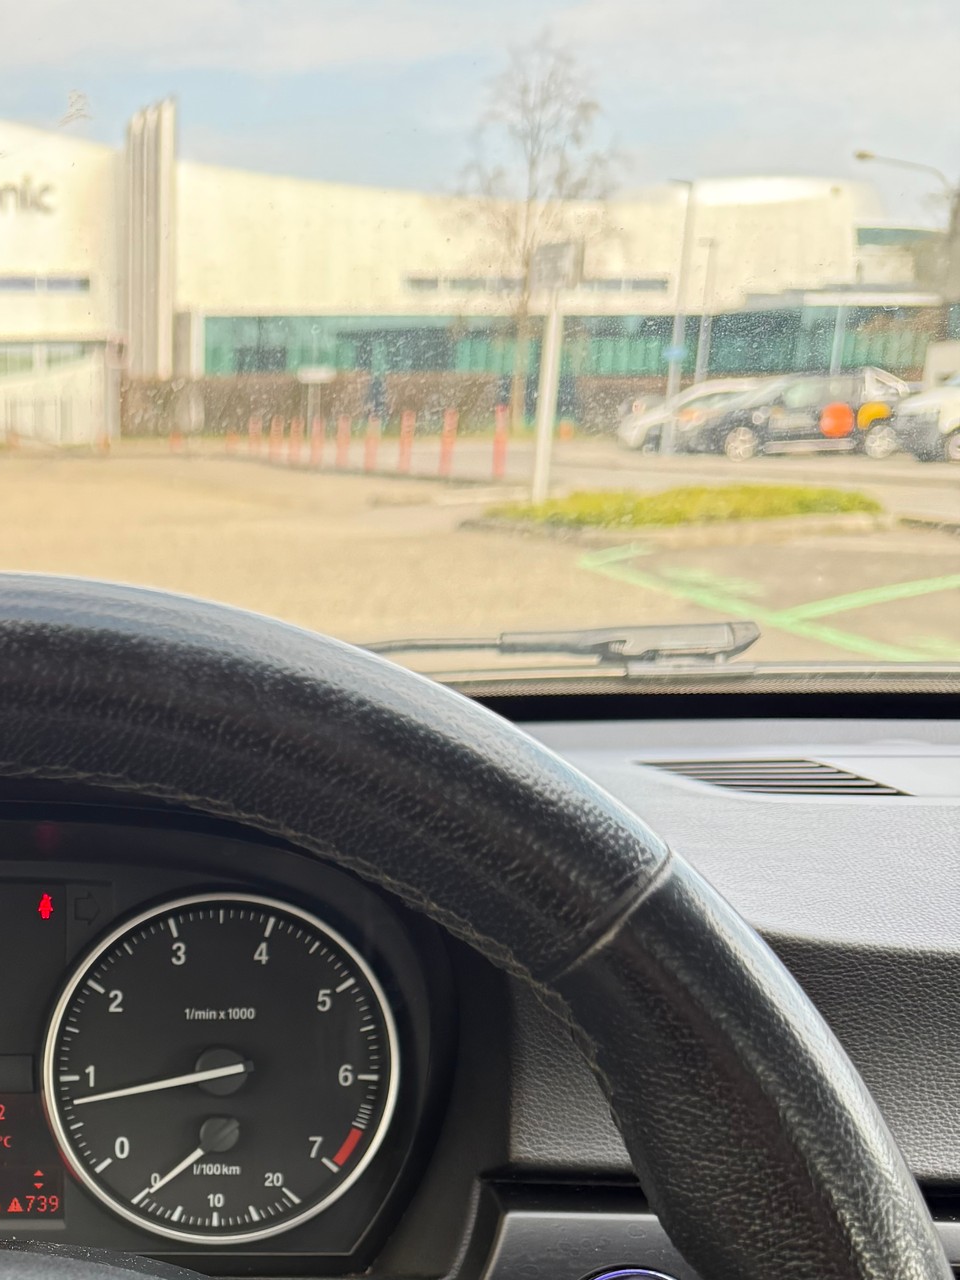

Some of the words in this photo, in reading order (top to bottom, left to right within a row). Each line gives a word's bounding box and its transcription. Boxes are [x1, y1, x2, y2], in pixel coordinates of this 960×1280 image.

[172, 943, 186, 965] 3
[254, 943, 268, 964] 4
[108, 990, 123, 1012] 2
[317, 989, 331, 1011] 5
[184, 1008, 216, 1019] 1/min
[219, 1011, 225, 1019] x
[228, 1008, 255, 1019] 1000
[85, 1065, 95, 1087] 1
[339, 1064, 352, 1086] 6
[115, 1136, 129, 1159] 0
[309, 1136, 323, 1158] 7
[264, 1173, 282, 1187] 20
[26, 1196, 59, 1212] 739
[207, 1194, 224, 1207] 10
